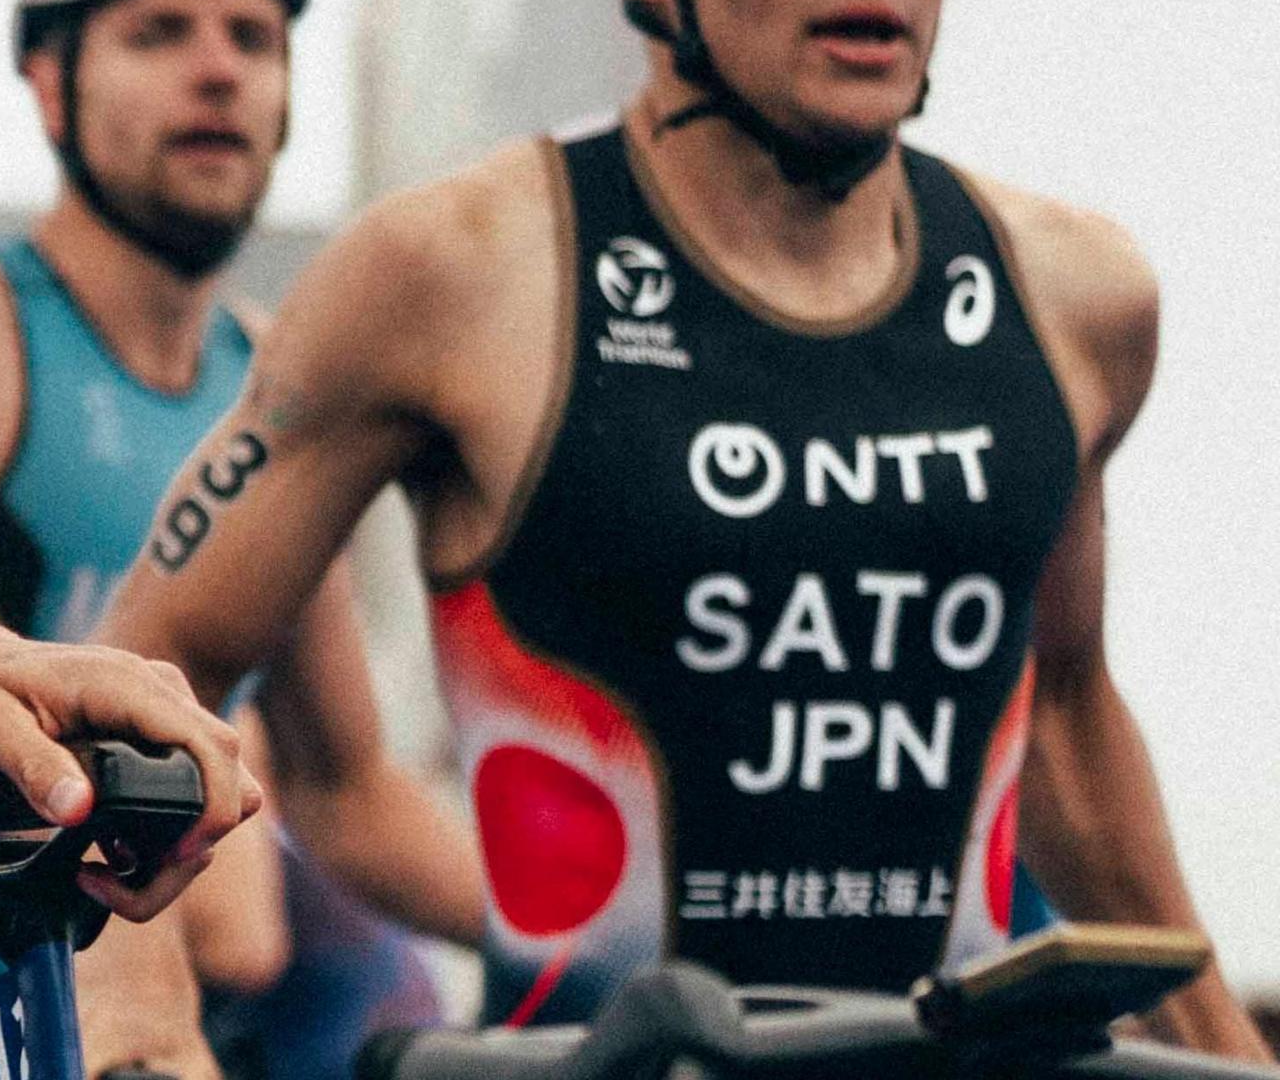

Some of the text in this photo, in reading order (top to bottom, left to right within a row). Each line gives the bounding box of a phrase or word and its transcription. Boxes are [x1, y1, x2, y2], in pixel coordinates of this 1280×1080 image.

[802, 424, 993, 508] NTT
[674, 569, 1006, 673] SATO
[727, 698, 956, 795] JPN
